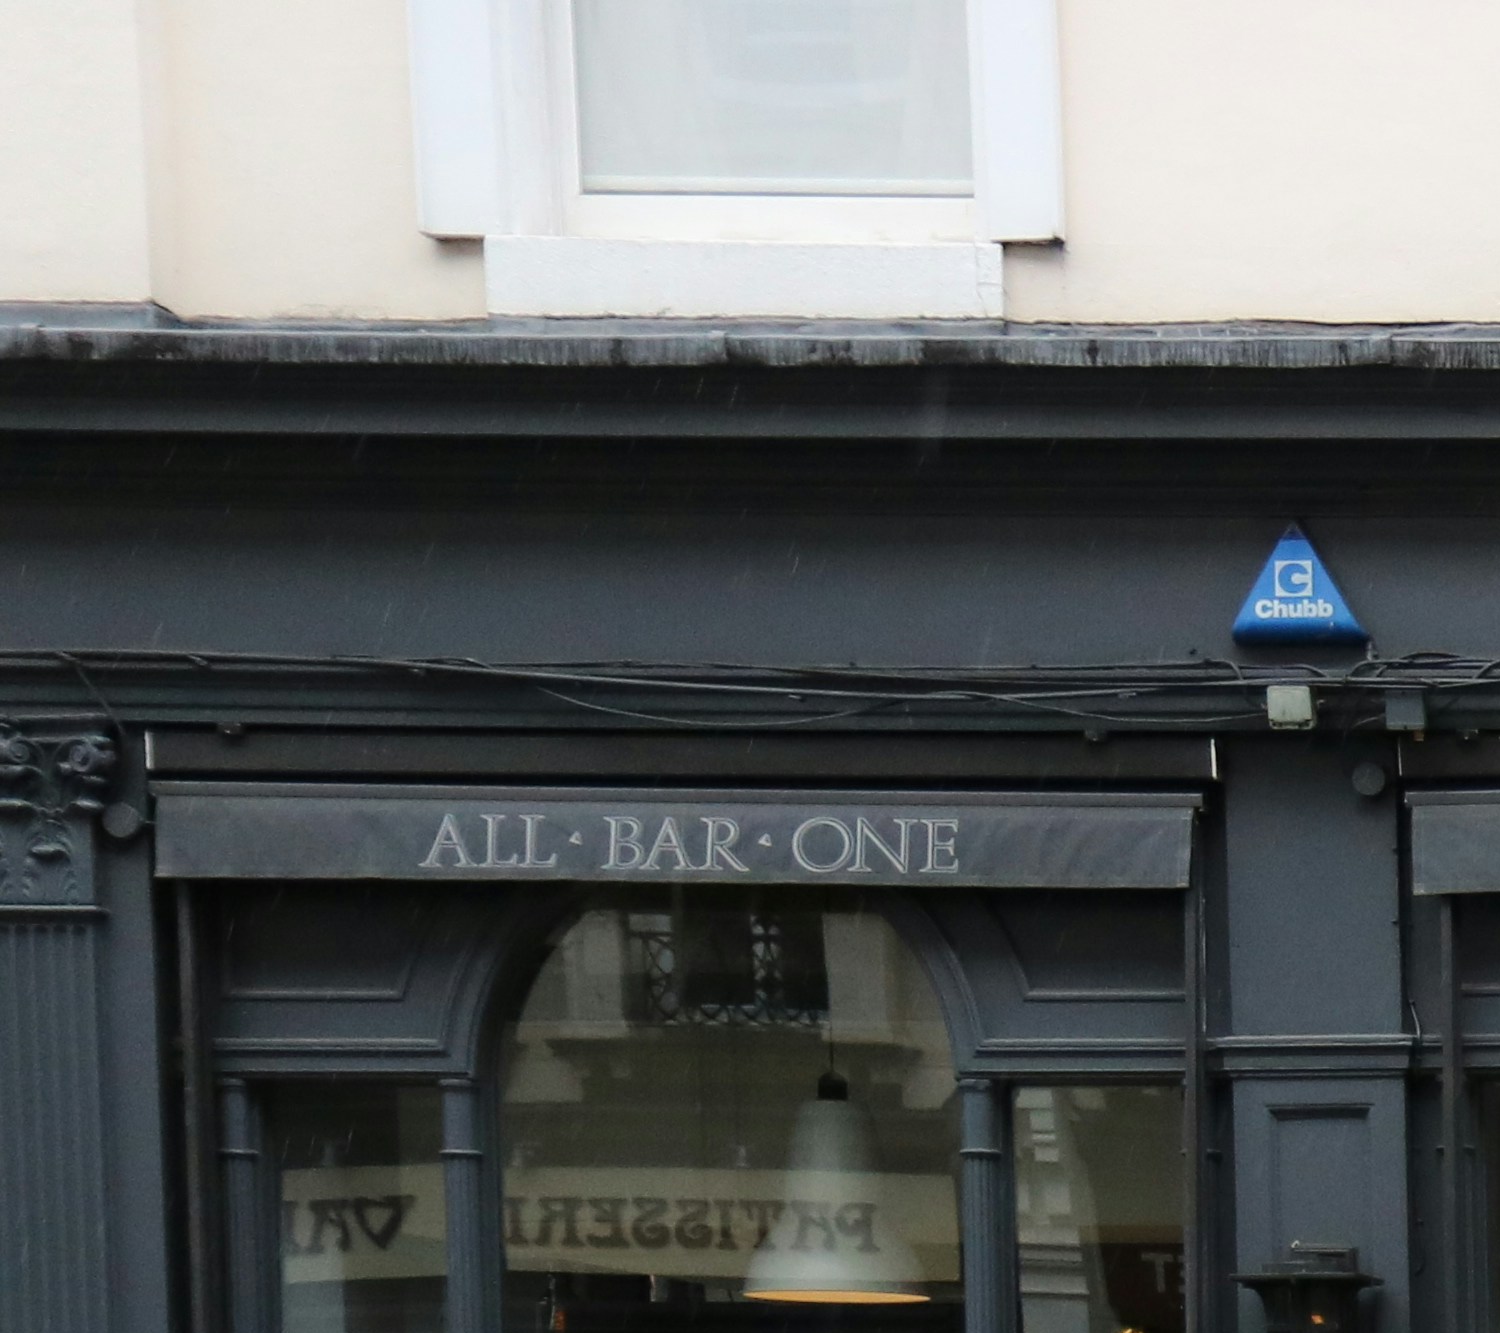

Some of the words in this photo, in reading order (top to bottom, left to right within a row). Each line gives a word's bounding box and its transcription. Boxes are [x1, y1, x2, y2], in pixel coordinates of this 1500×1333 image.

[1254, 599, 1334, 618] Chubb
[418, 813, 558, 868] ALL
[601, 816, 750, 873] BAR
[792, 816, 959, 874] ONE
